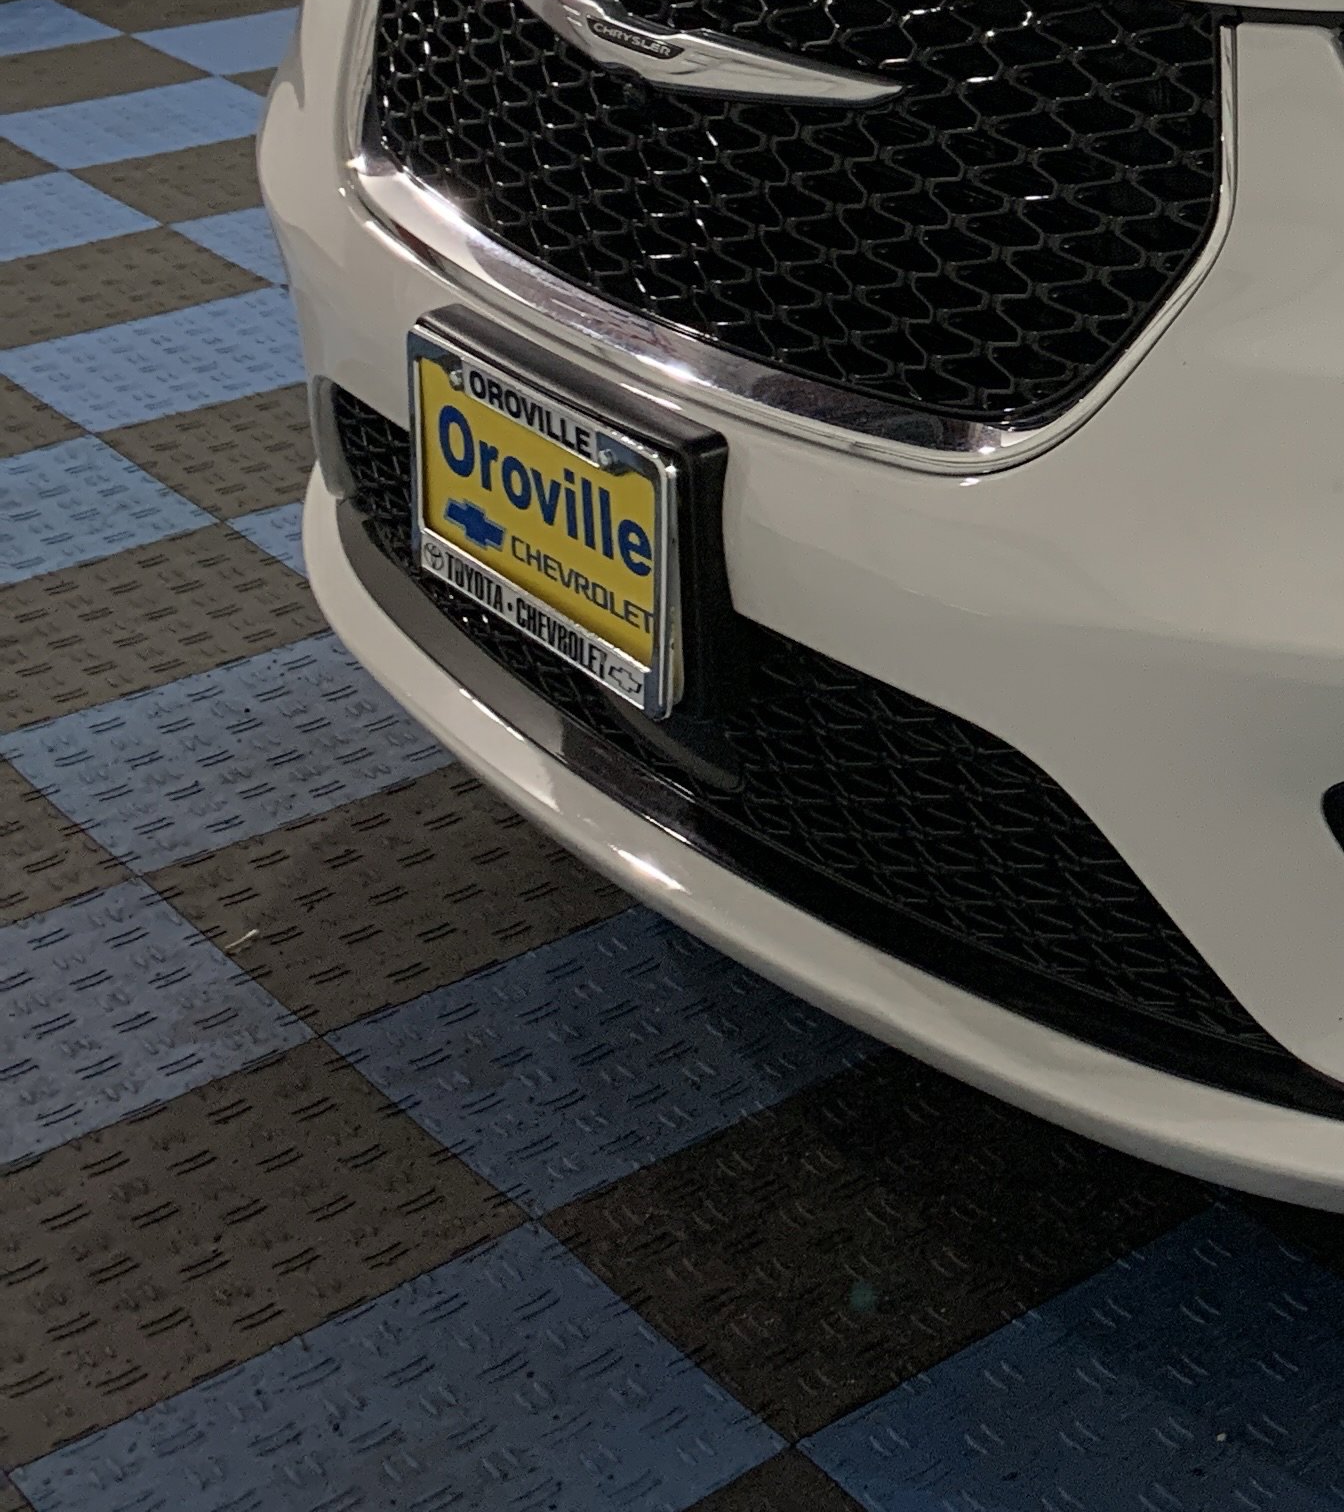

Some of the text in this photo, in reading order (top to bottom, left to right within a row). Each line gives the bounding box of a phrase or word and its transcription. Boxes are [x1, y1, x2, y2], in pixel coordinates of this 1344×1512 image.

[593, 22, 671, 57] CHRYSLER
[469, 370, 592, 459] OROVILLE
[438, 405, 653, 576] Oroville
[445, 551, 607, 680] TOYOTA CHEVROLET
[511, 535, 653, 634] CHEVROLET
